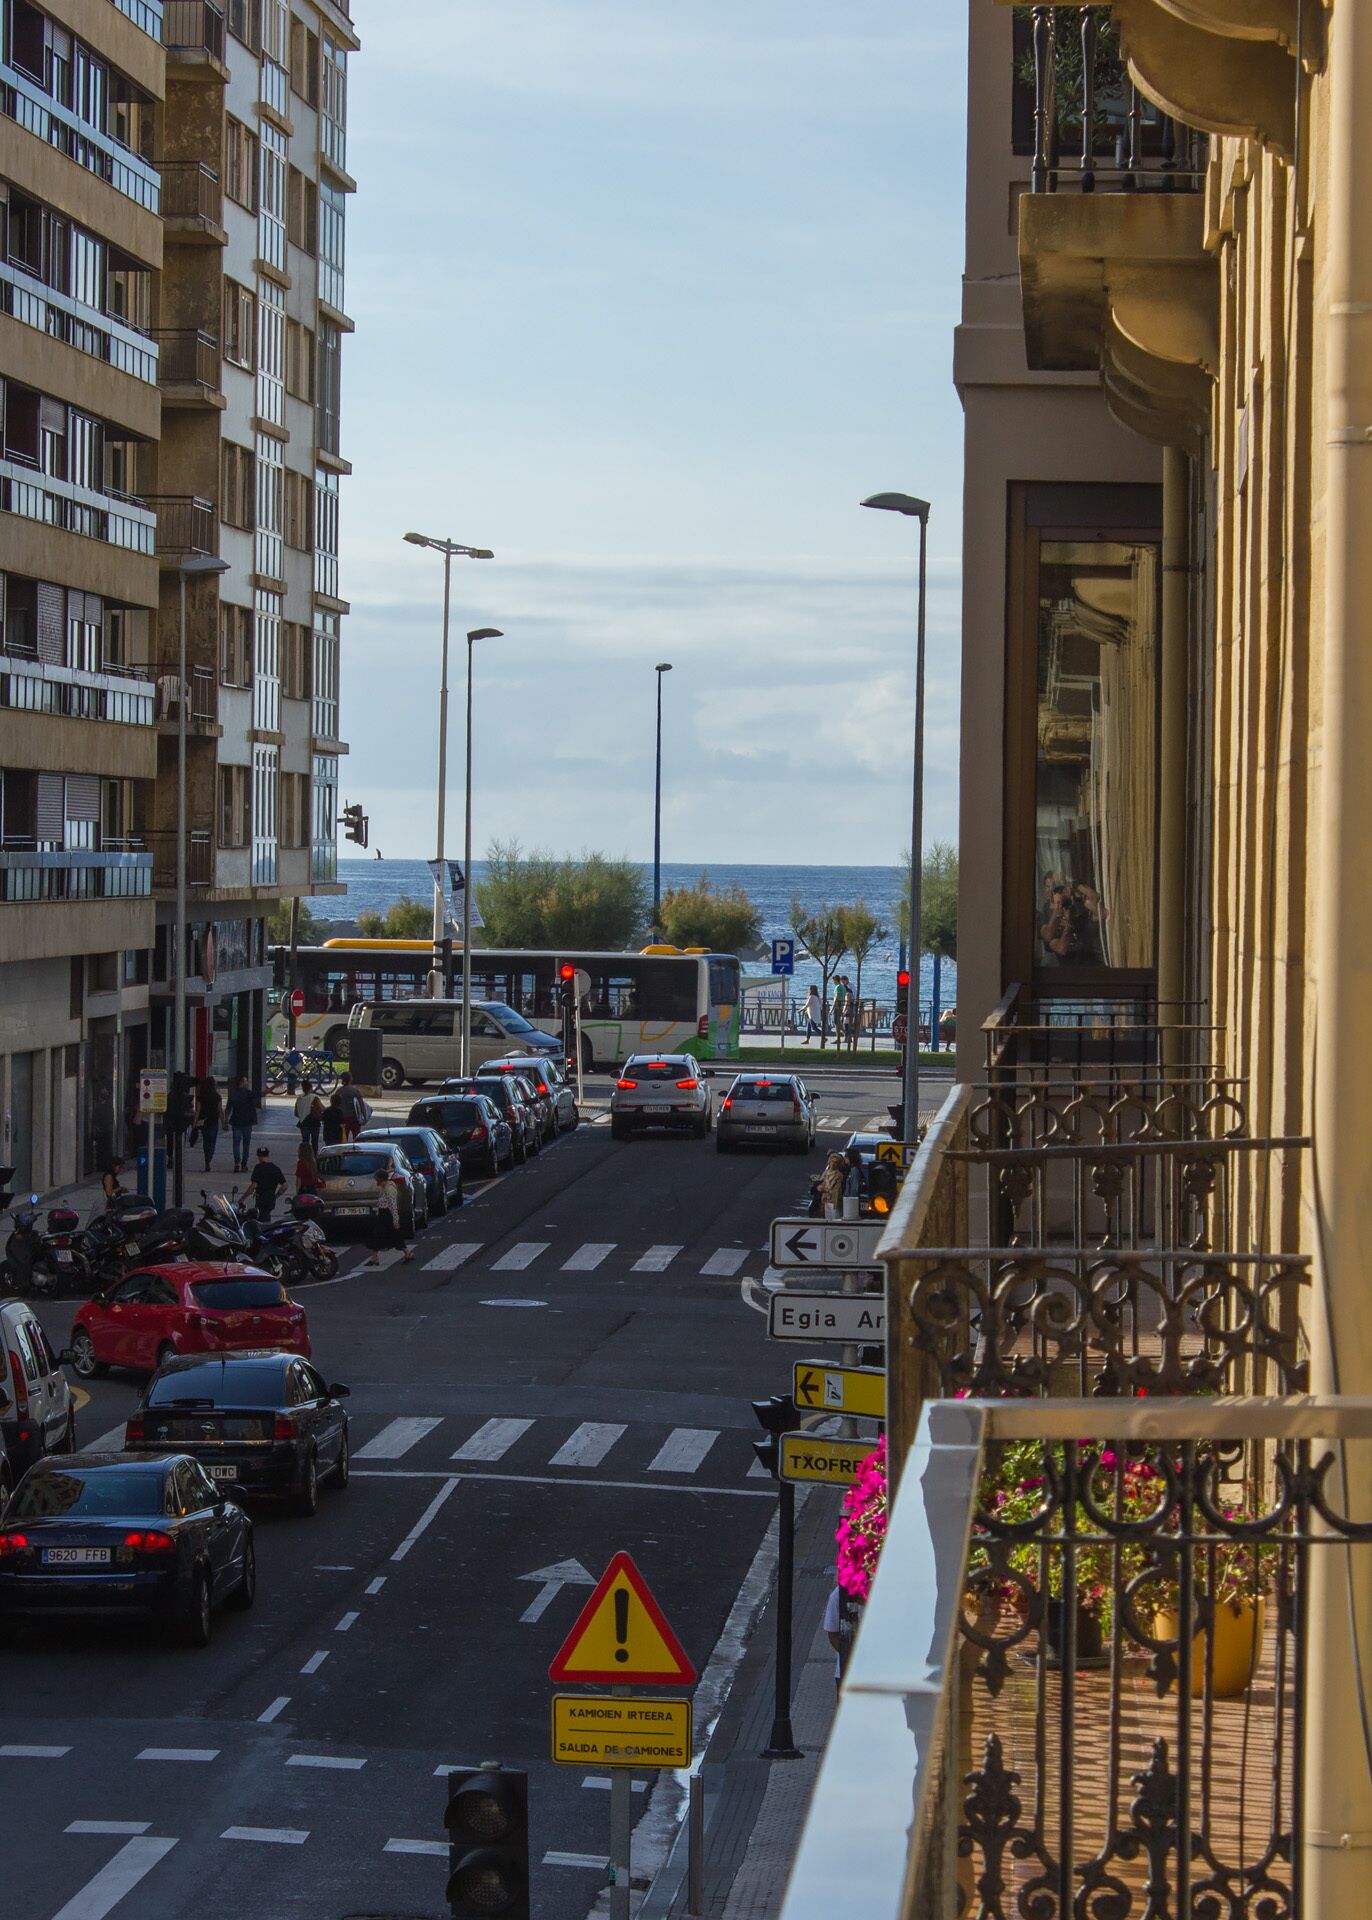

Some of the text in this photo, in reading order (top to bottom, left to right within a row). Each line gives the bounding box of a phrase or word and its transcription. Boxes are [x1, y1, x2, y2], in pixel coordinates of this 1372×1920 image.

[776, 942, 790, 961] P
[782, 1308, 836, 1329] Egia
[48, 1550, 107, 1561] 9620 FFB
[569, 1708, 673, 1721] KAMIOIEN IRTEERA
[559, 1743, 683, 1757] SALIDA DE CAMIONES
